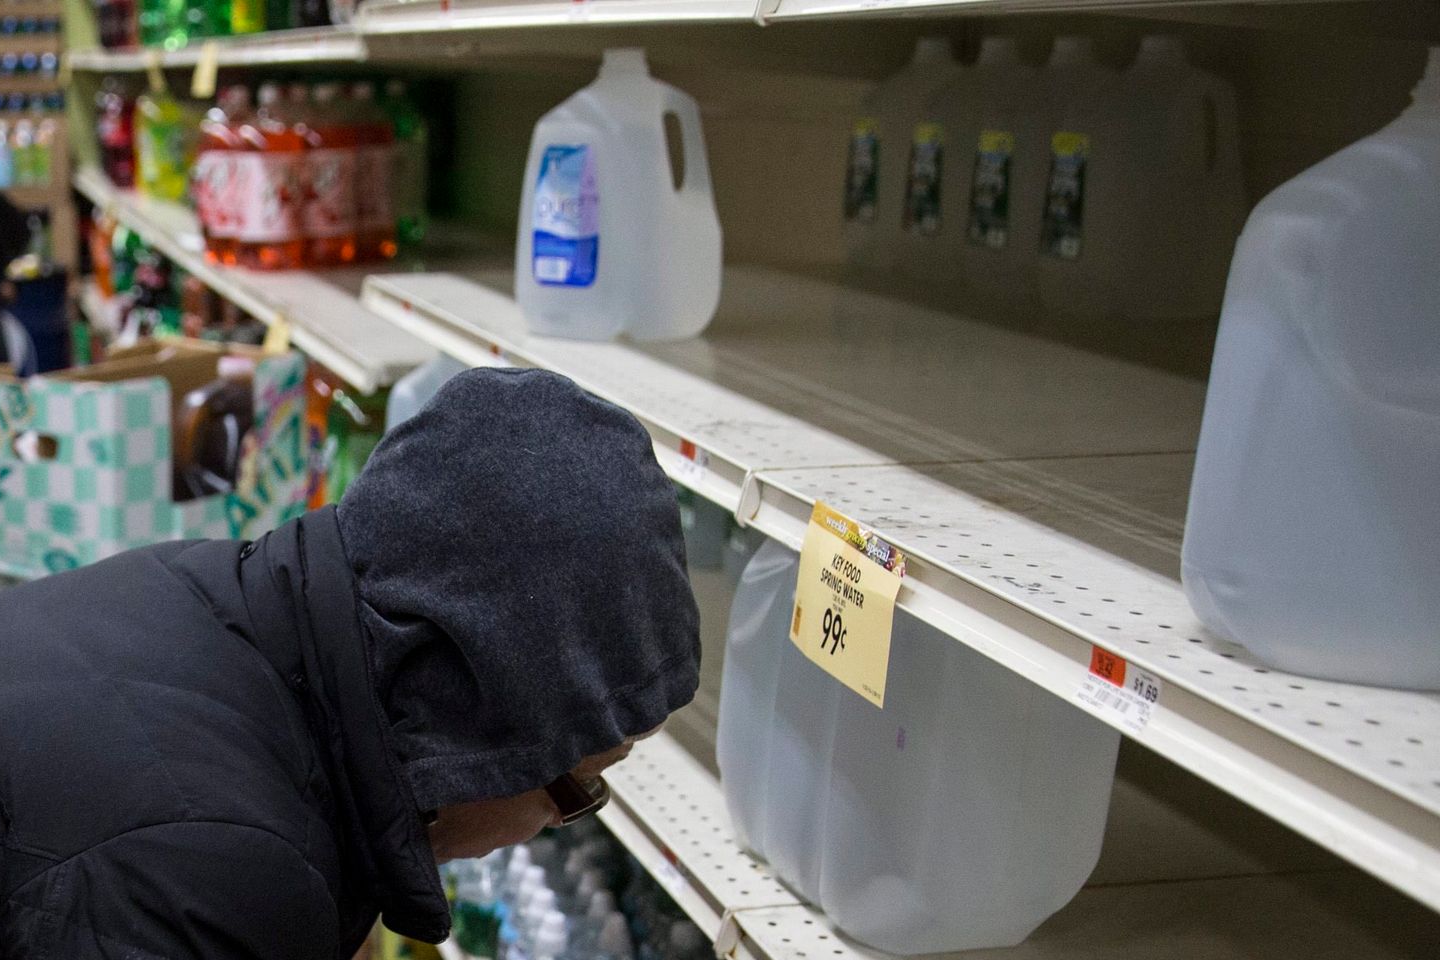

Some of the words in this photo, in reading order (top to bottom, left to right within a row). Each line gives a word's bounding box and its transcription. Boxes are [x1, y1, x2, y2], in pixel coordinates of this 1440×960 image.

[865, 541, 891, 562] special
[832, 553, 844, 571] KEY
[843, 560, 862, 584] FOOD
[820, 567, 842, 594] SPRING
[843, 583, 865, 609] WATER
[1133, 677, 1158, 703] $1.69
